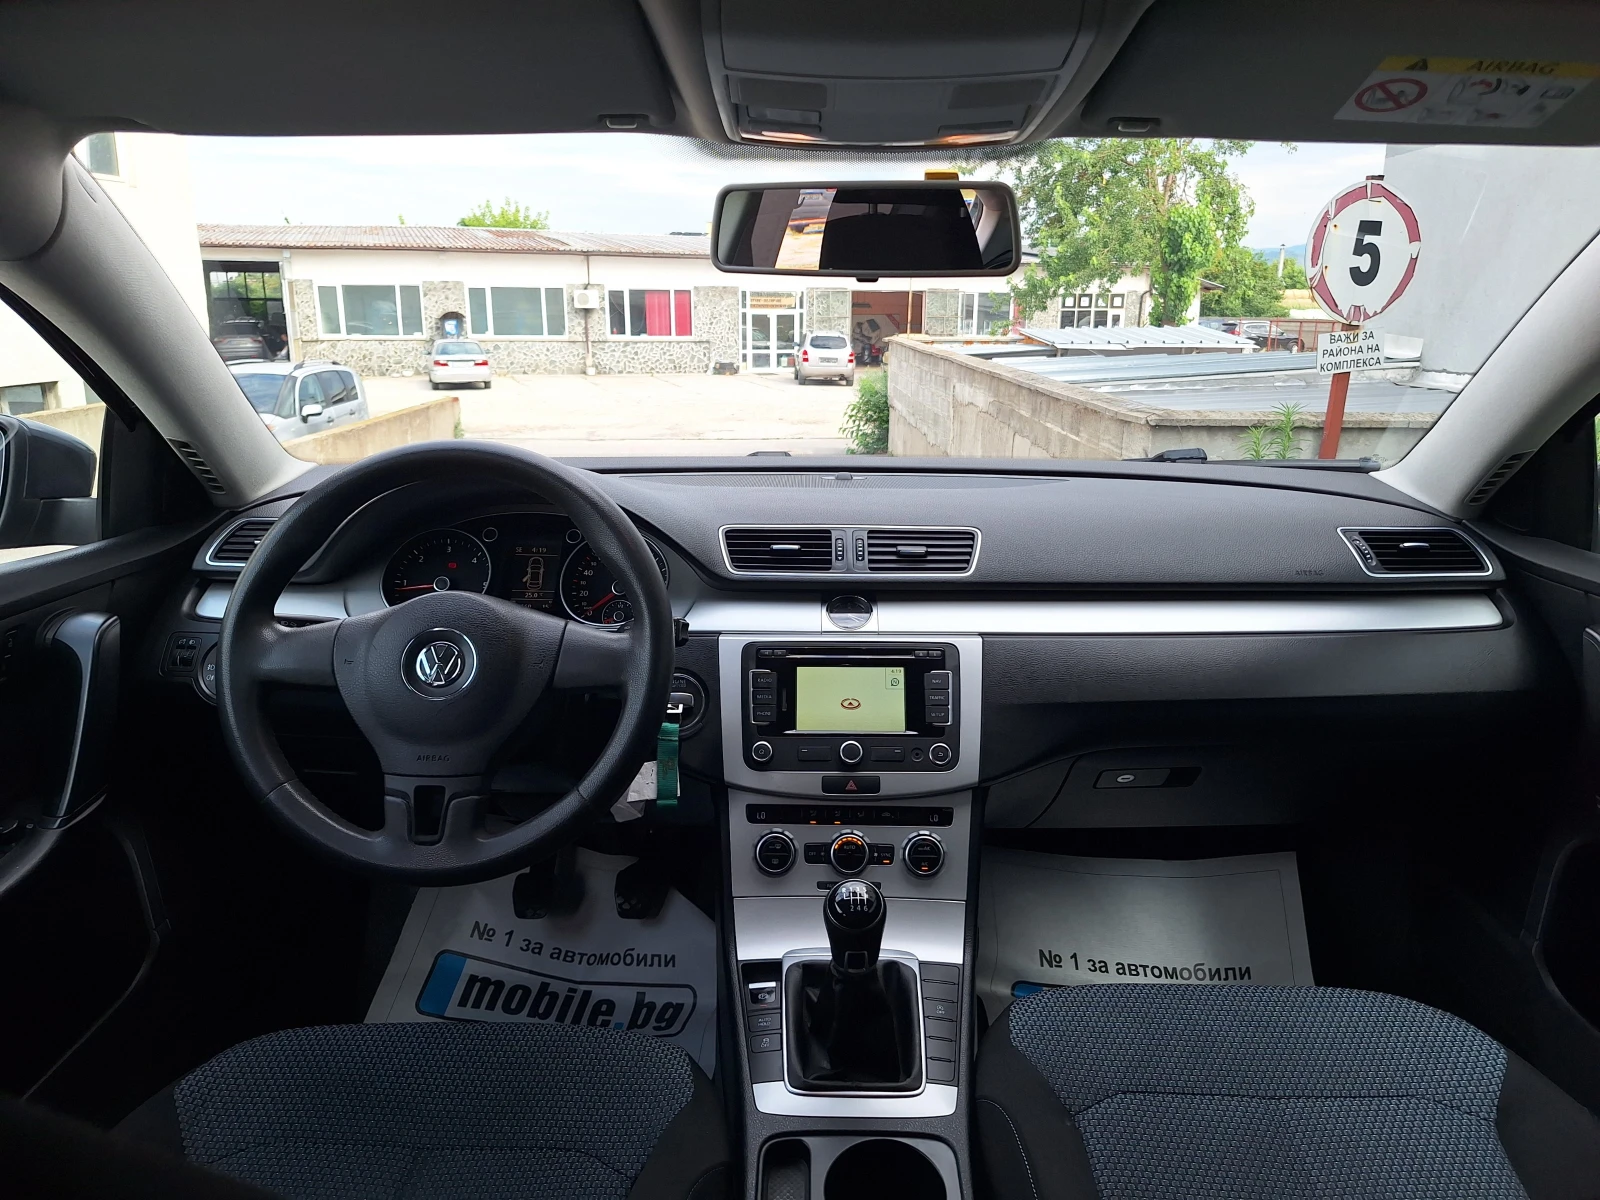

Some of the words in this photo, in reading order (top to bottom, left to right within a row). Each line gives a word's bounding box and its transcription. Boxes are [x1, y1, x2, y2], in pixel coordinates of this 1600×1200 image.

[1466, 60, 1560, 75] AIRBAG
[1349, 219, 1383, 287] 5
[1329, 332, 1360, 345] ВАЖИ
[1361, 330, 1375, 341] ЗА
[1322, 344, 1364, 359] РАЙОНА
[1366, 342, 1381, 354] НА
[1319, 356, 1382, 373] КОМПЛЕКСА
[446, 545, 452, 553] 3
[418, 555, 424, 563] 2
[415, 754, 450, 762] AIRBAG
[469, 920, 496, 942] №
[503, 929, 515, 948] 1
[519, 937, 544, 956] за
[549, 947, 677, 969] автомобили
[1038, 948, 1063, 969] №
[1070, 952, 1080, 971] 1
[1087, 958, 1109, 974] за
[1115, 961, 1252, 982] автомобили
[456, 973, 686, 1032] mobile.bg
